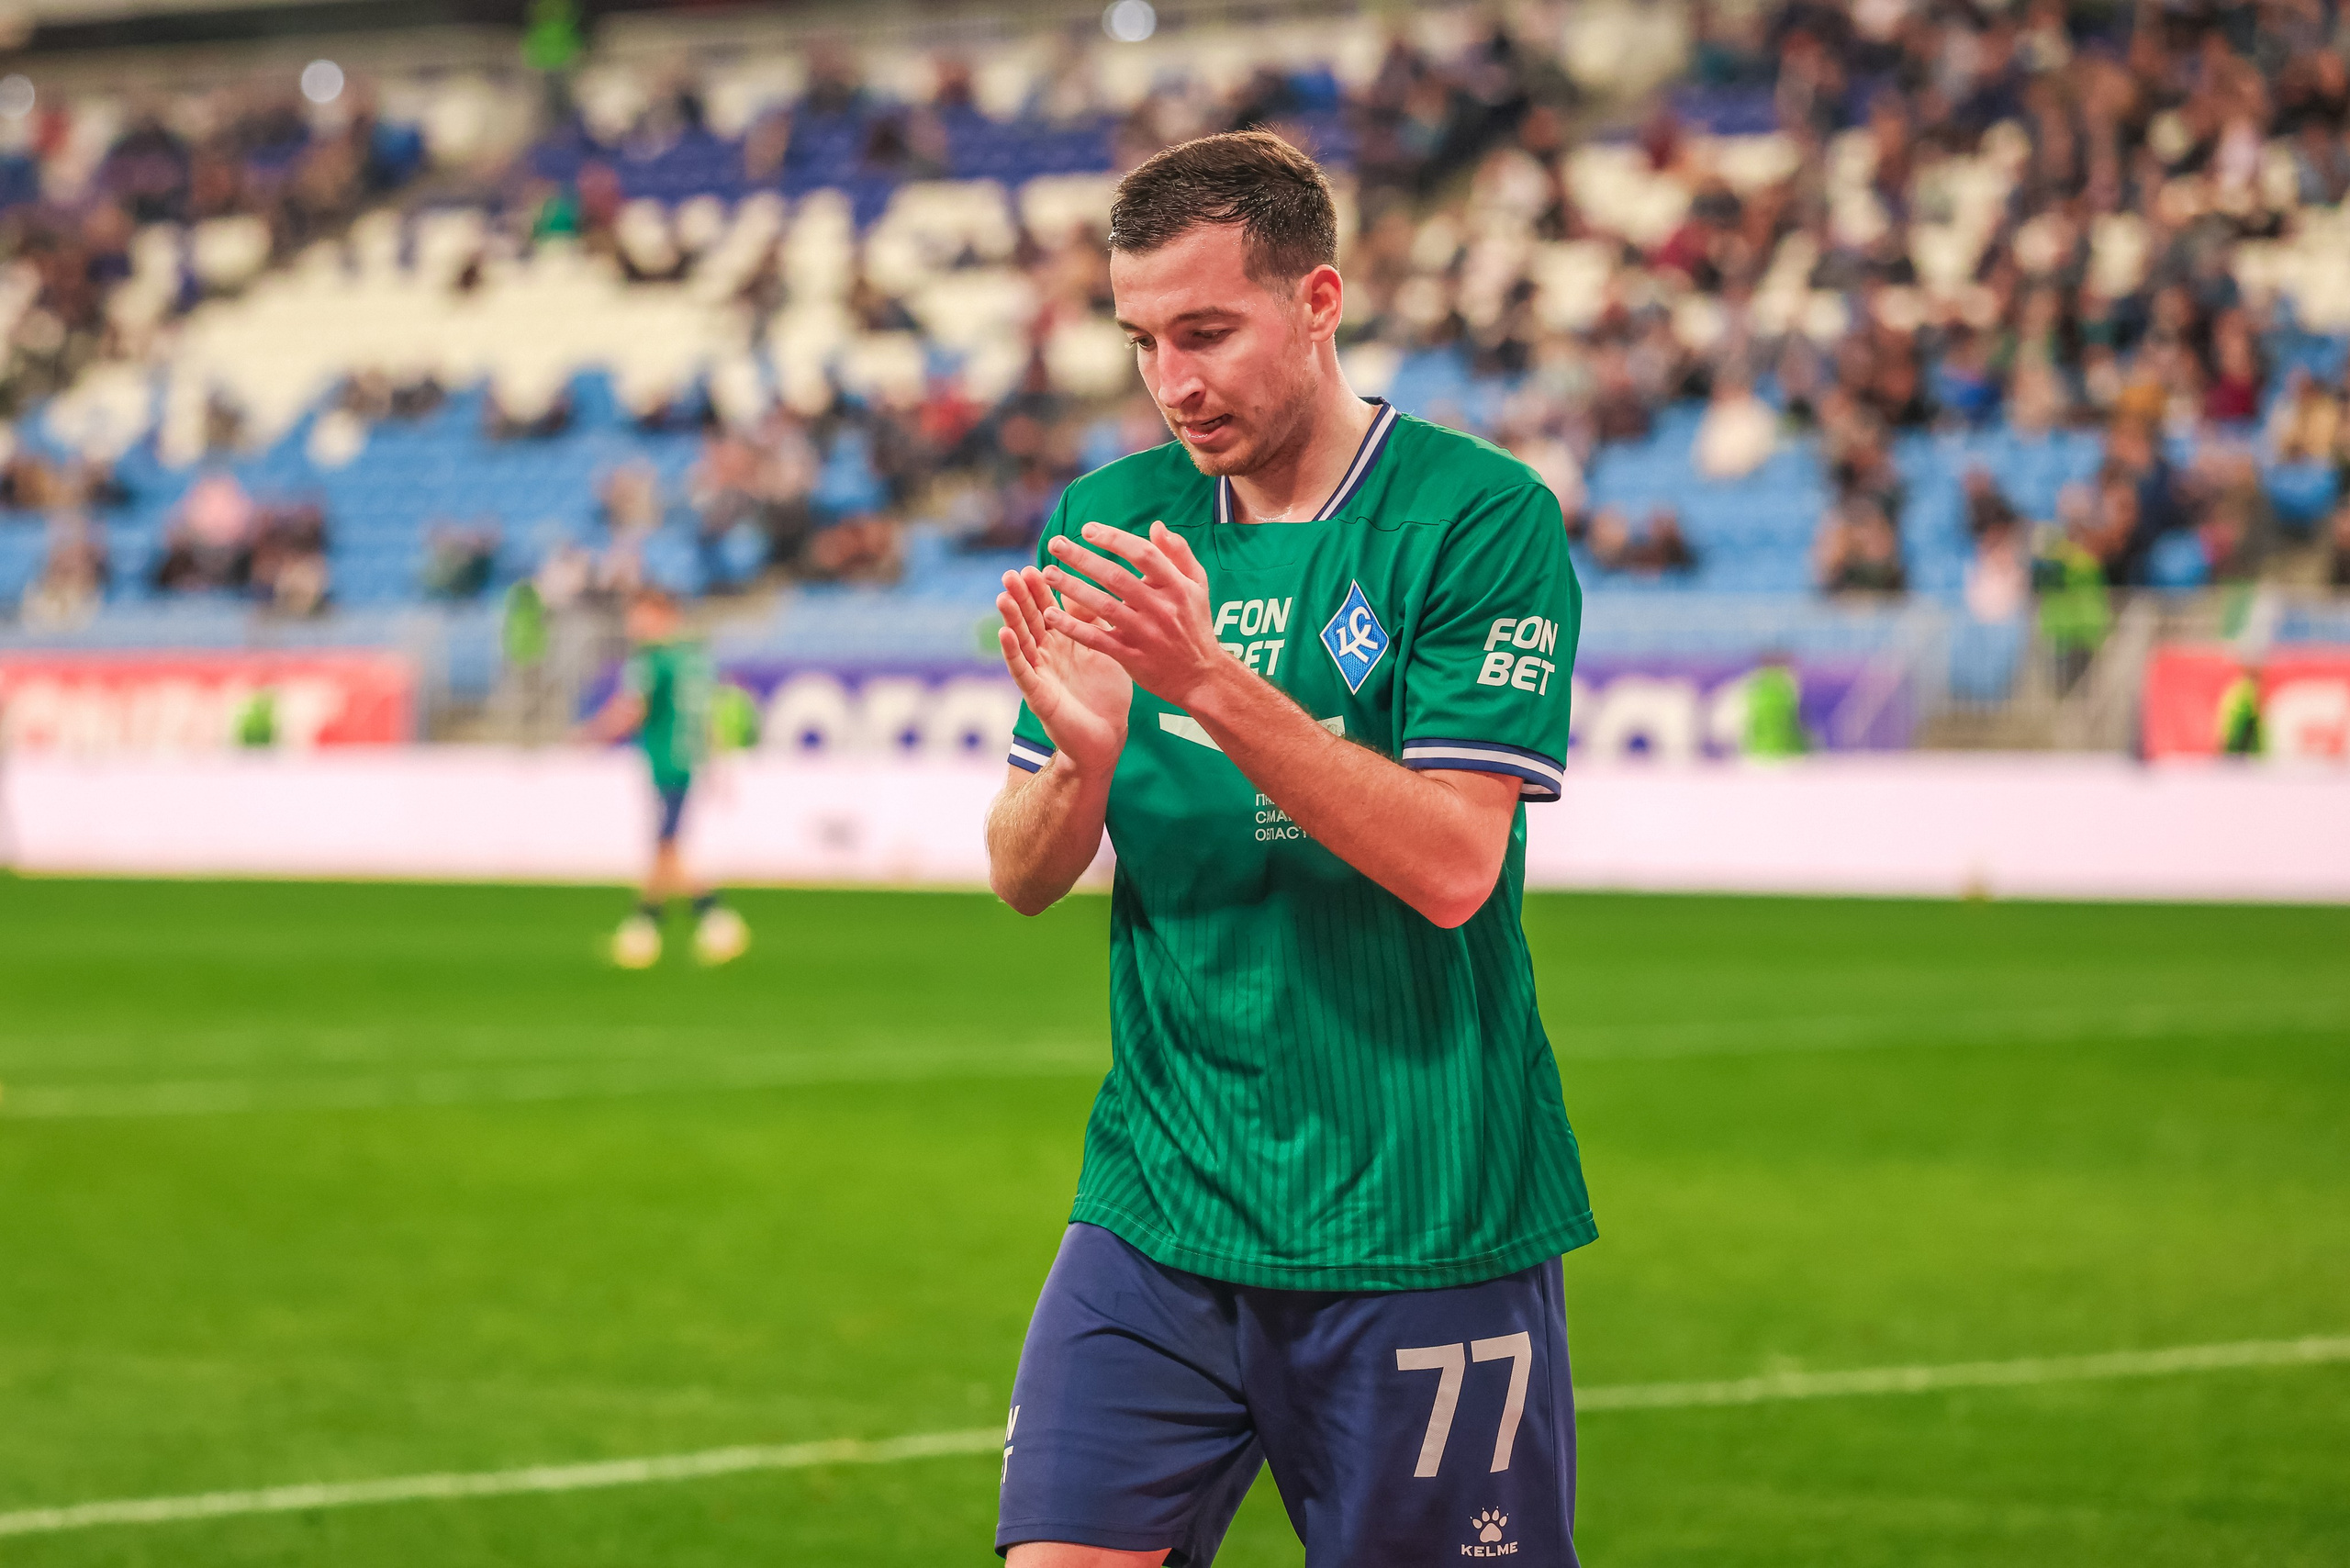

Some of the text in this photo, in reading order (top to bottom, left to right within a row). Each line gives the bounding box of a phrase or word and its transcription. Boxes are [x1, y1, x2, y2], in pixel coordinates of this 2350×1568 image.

[1214, 597, 1292, 636] FON
[1483, 615, 1559, 656] FON
[1476, 652, 1556, 696] BET
[1396, 1330, 1532, 1478] 77
[1460, 1541, 1518, 1557] KELME
